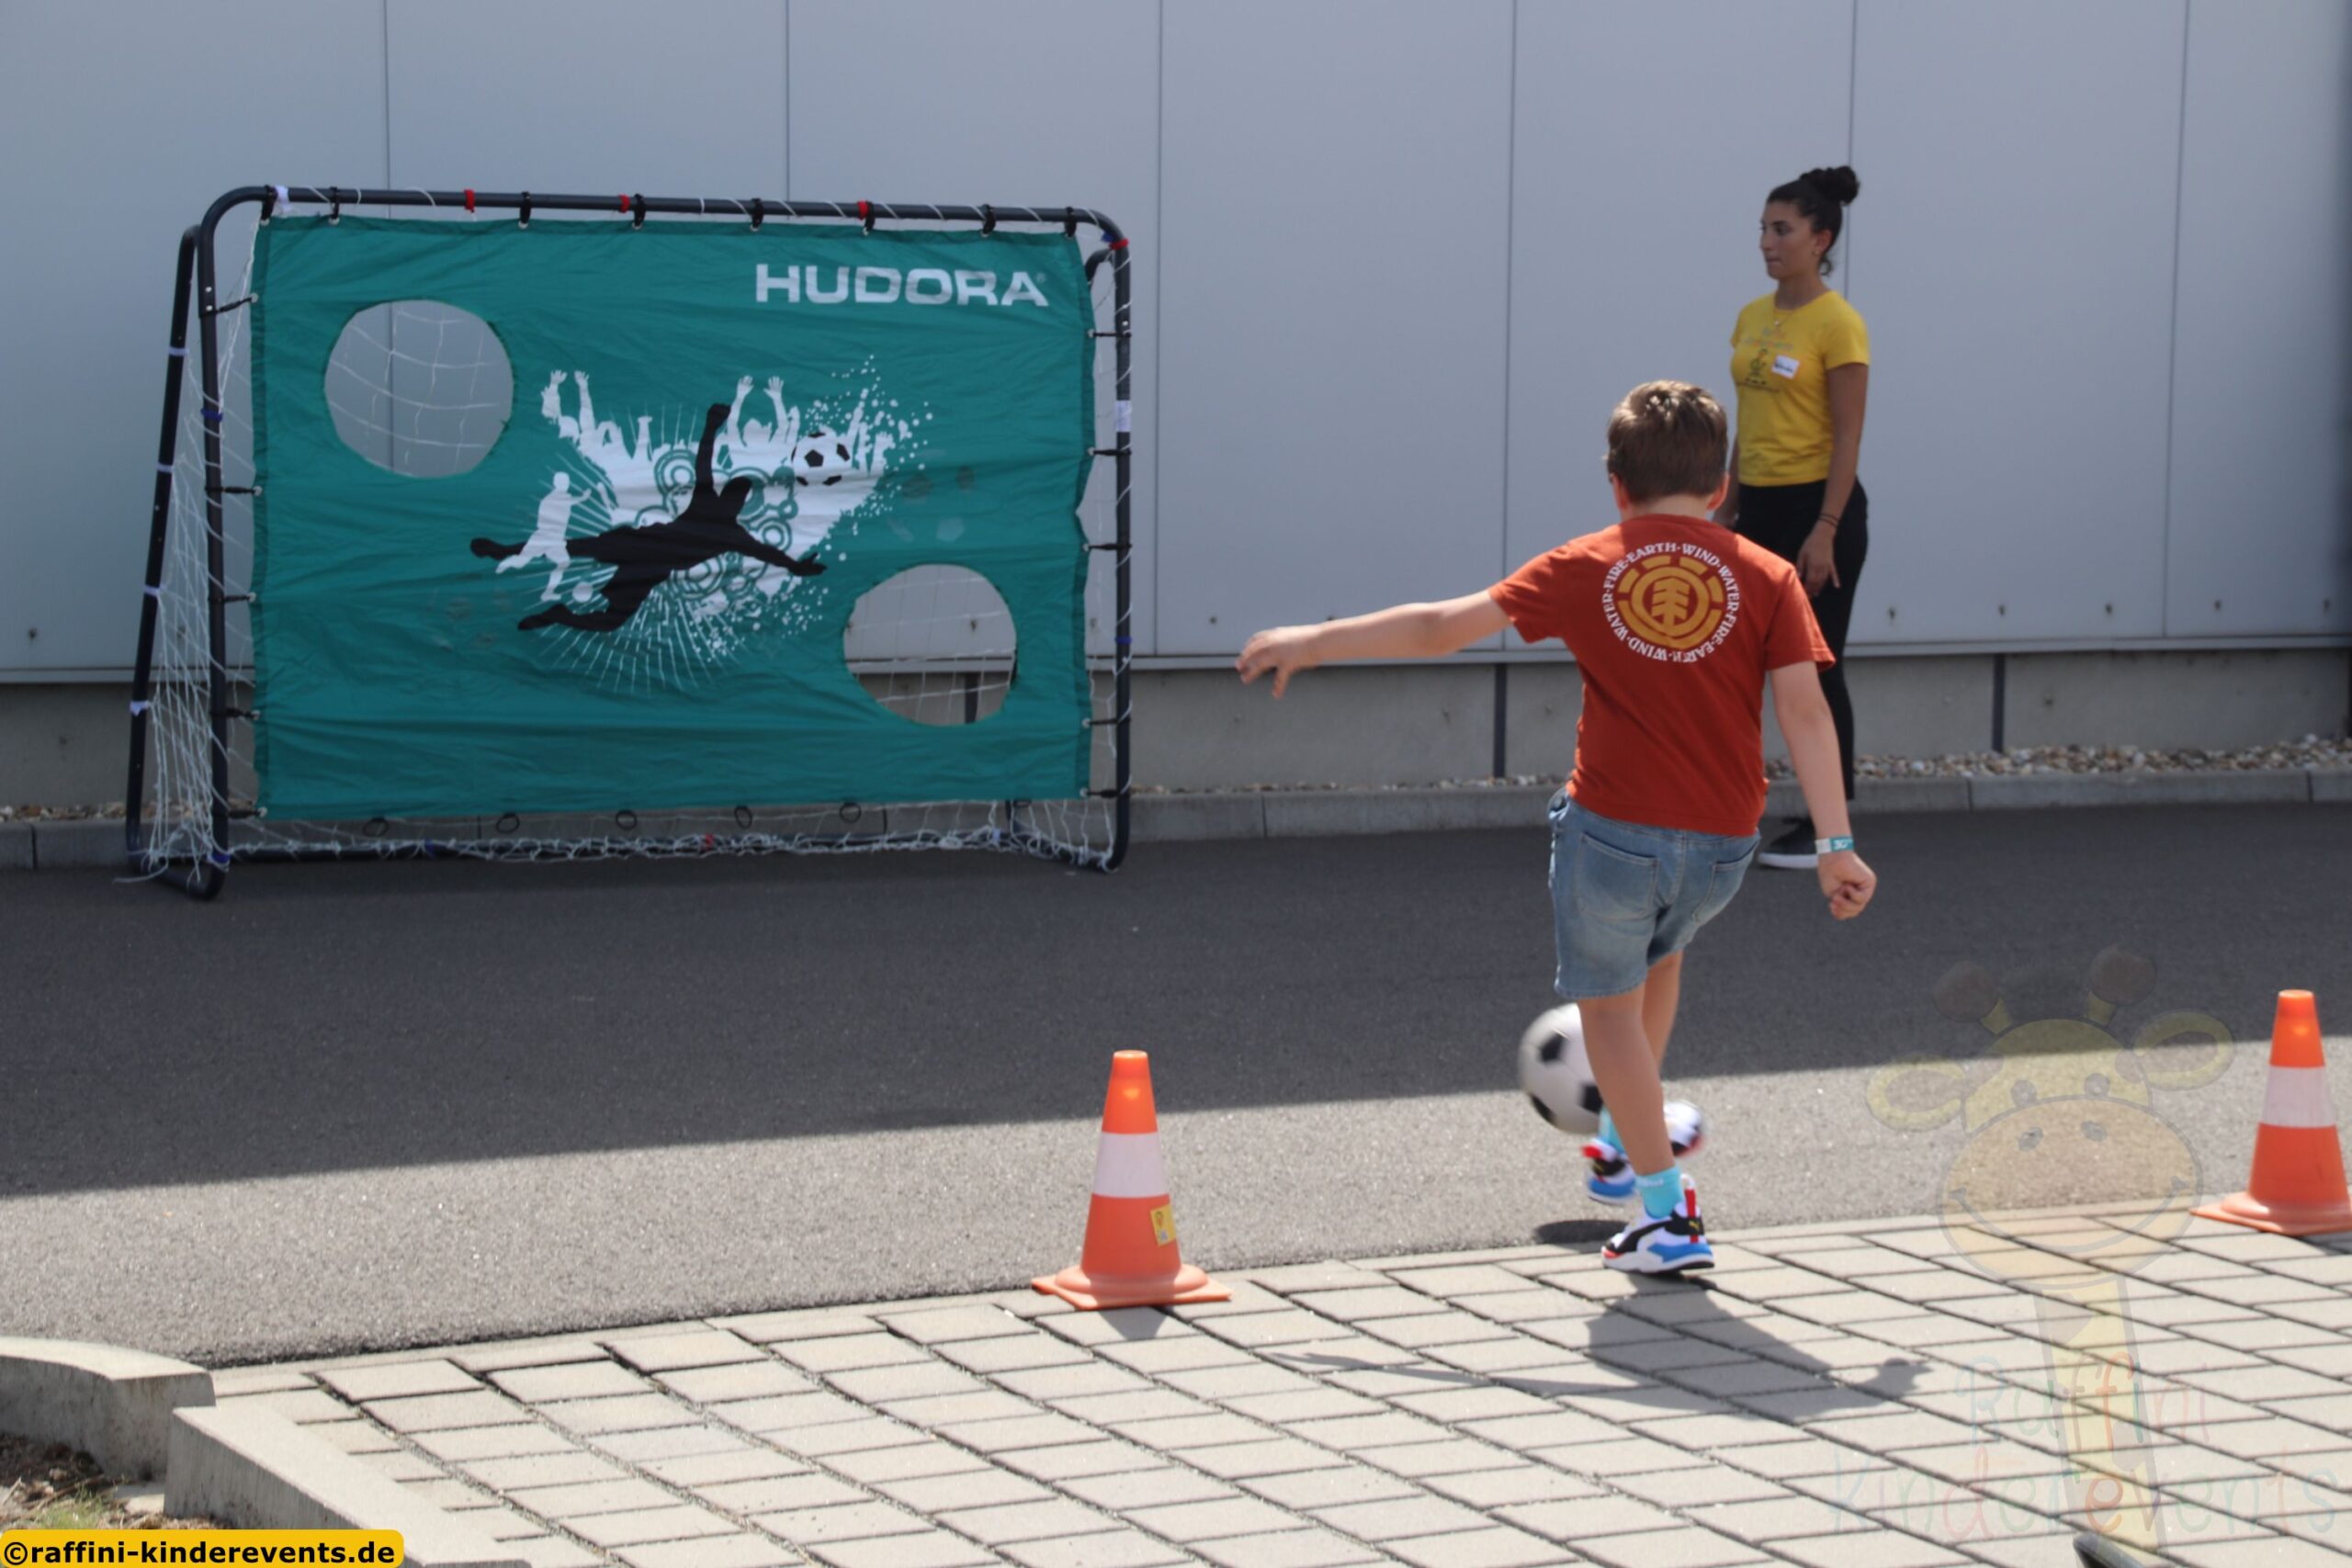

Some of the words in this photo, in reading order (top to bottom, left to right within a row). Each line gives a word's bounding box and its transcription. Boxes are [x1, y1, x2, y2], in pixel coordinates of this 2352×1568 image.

[756, 264, 1049, 307] HUDORA
[1627, 542, 1676, 562] EARTH
[1682, 544, 1720, 566] WIND
[1603, 559, 1628, 590] FIRE
[1718, 565, 1739, 611] WATER
[1712, 615, 1736, 645] FIRE
[1628, 637, 1668, 661] WIND
